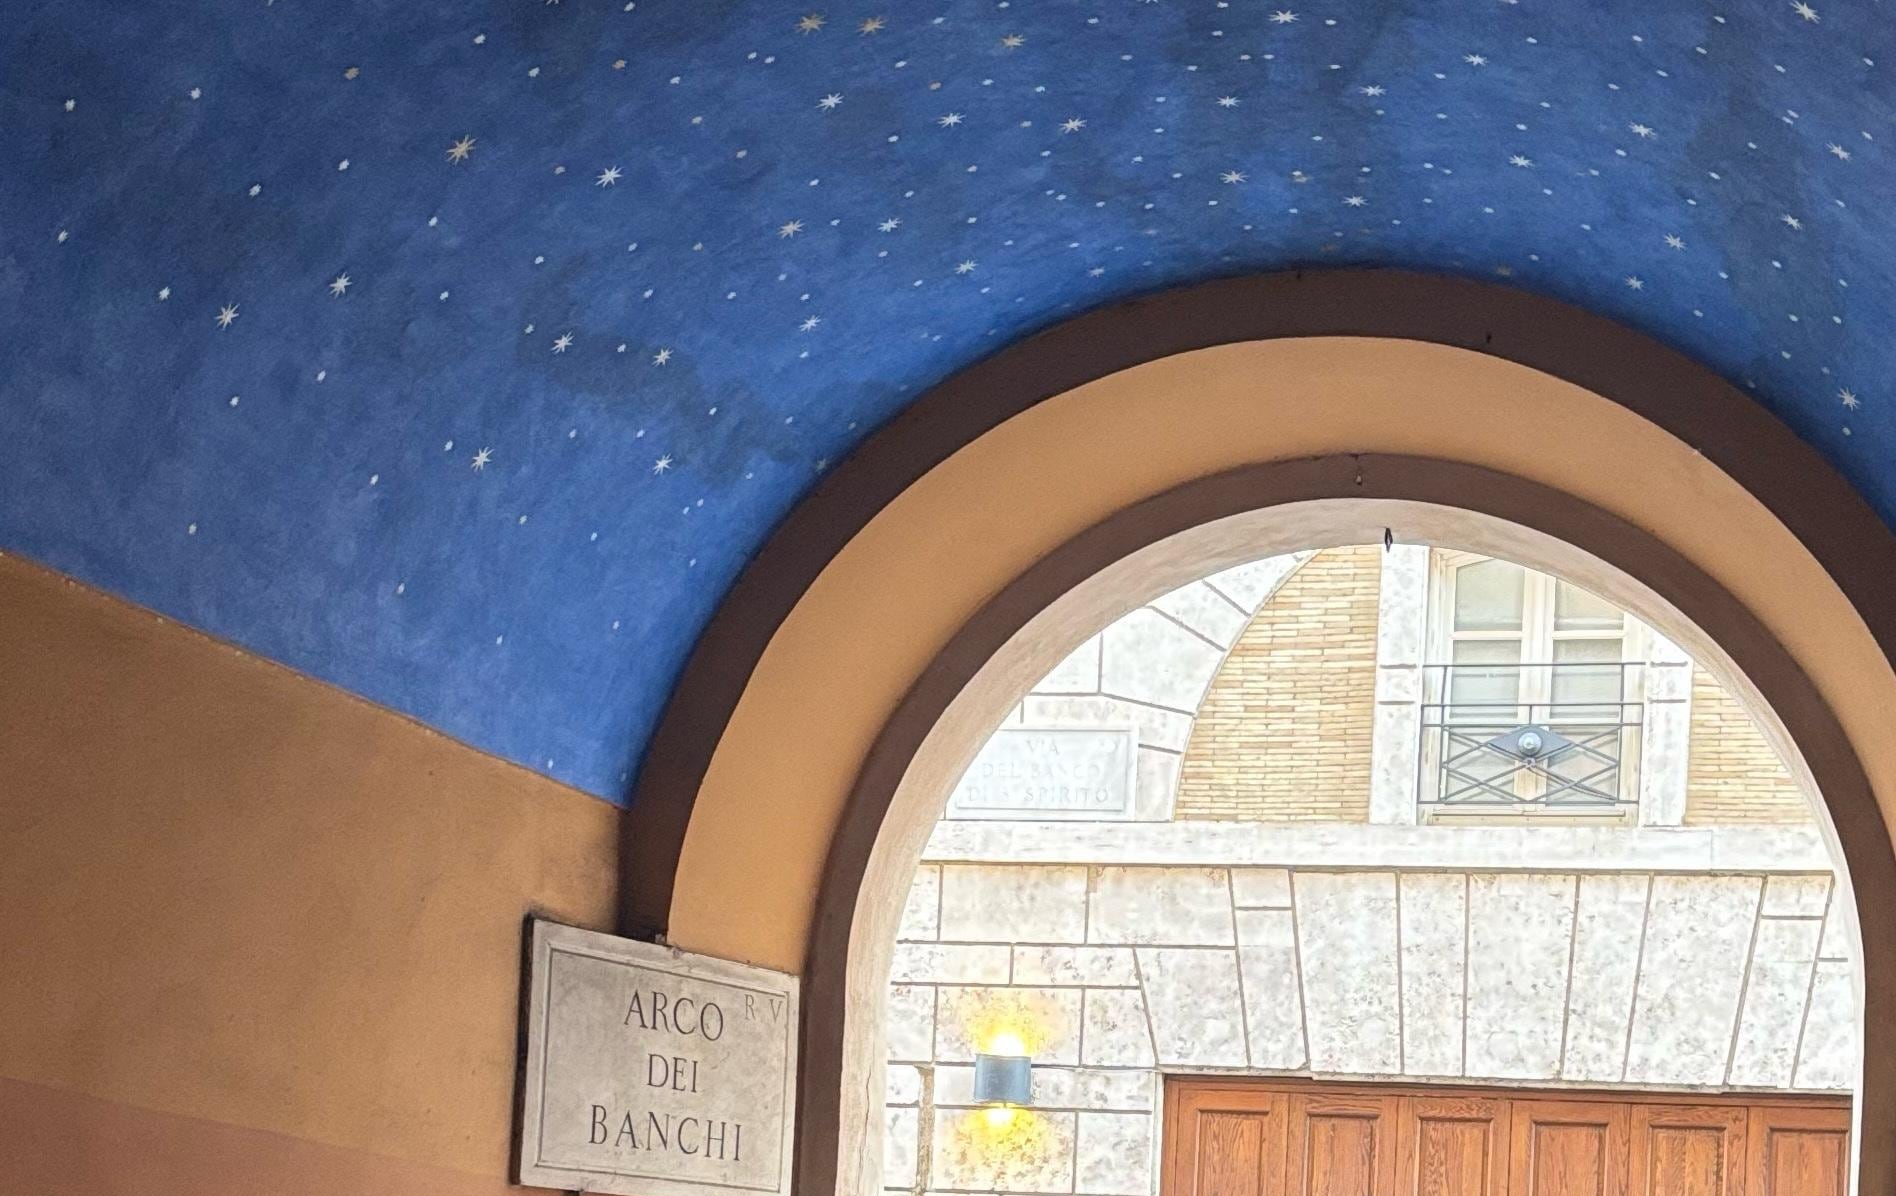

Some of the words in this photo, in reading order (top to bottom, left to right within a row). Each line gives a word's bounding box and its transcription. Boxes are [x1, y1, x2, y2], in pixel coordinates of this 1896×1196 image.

[1026, 738, 1060, 755] VIA
[981, 763, 1020, 778] DEL
[1023, 788, 1108, 803] SPIRITO
[624, 989, 723, 1041] ARCO
[647, 1053, 698, 1093] DEI
[588, 1104, 742, 1161] BANCHI
